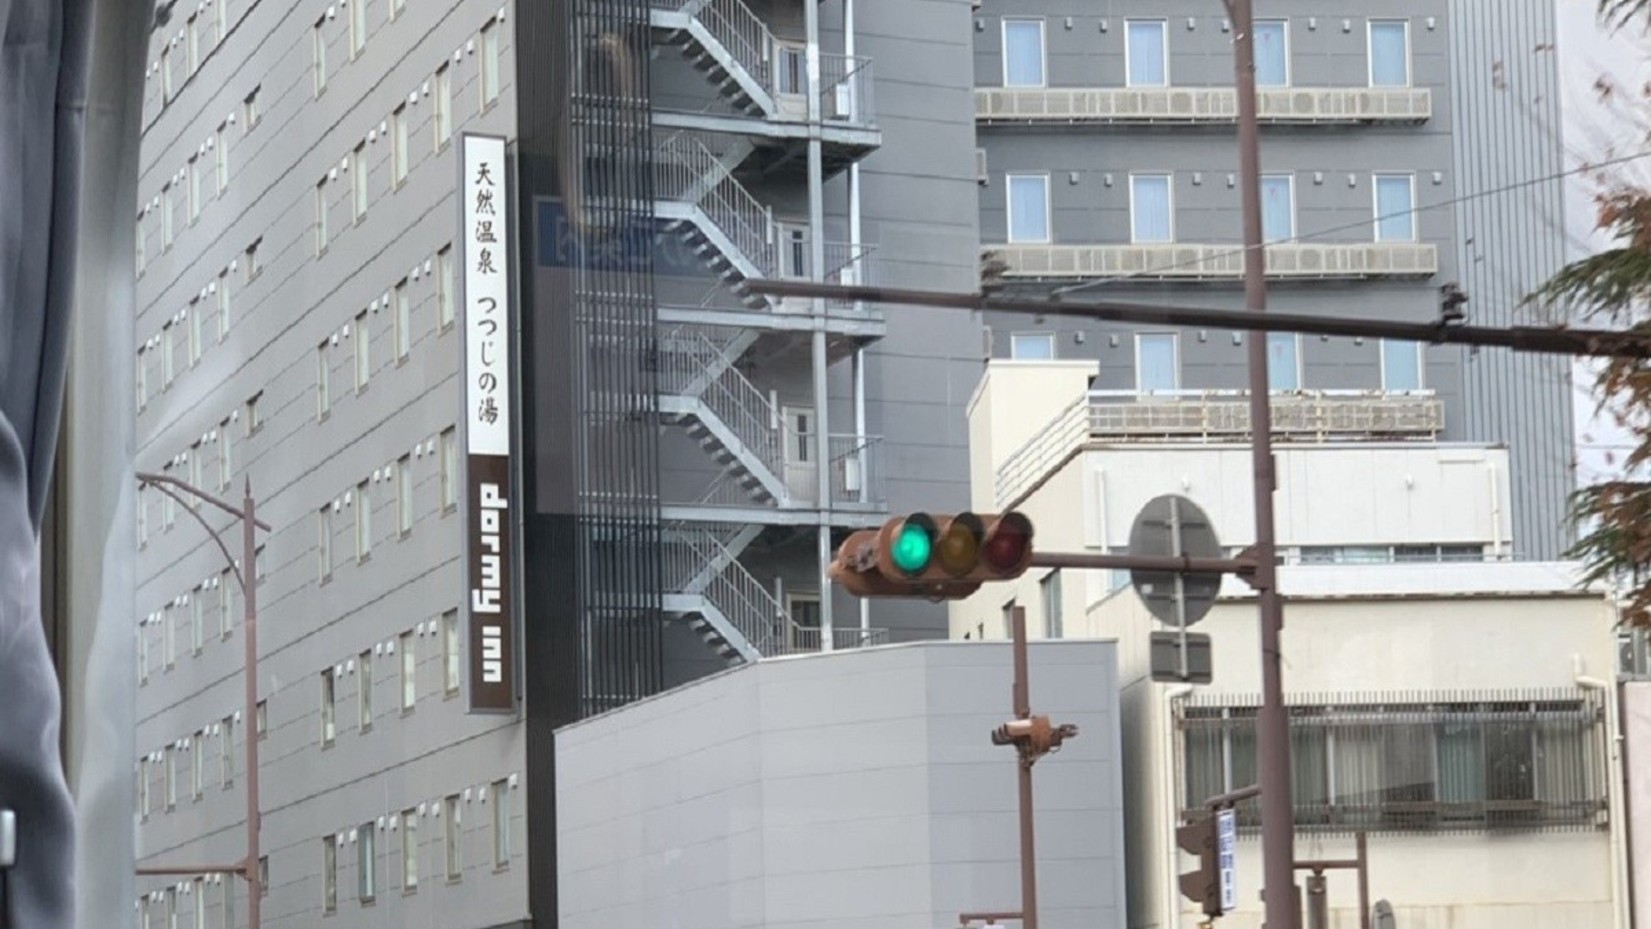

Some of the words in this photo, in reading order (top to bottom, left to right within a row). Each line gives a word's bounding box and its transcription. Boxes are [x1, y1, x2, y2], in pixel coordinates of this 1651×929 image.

[475, 162, 497, 275] 天然温泉
[477, 296, 498, 425] つつじの湯
[472, 483, 508, 613] dormy
[482, 626, 502, 683] inn
